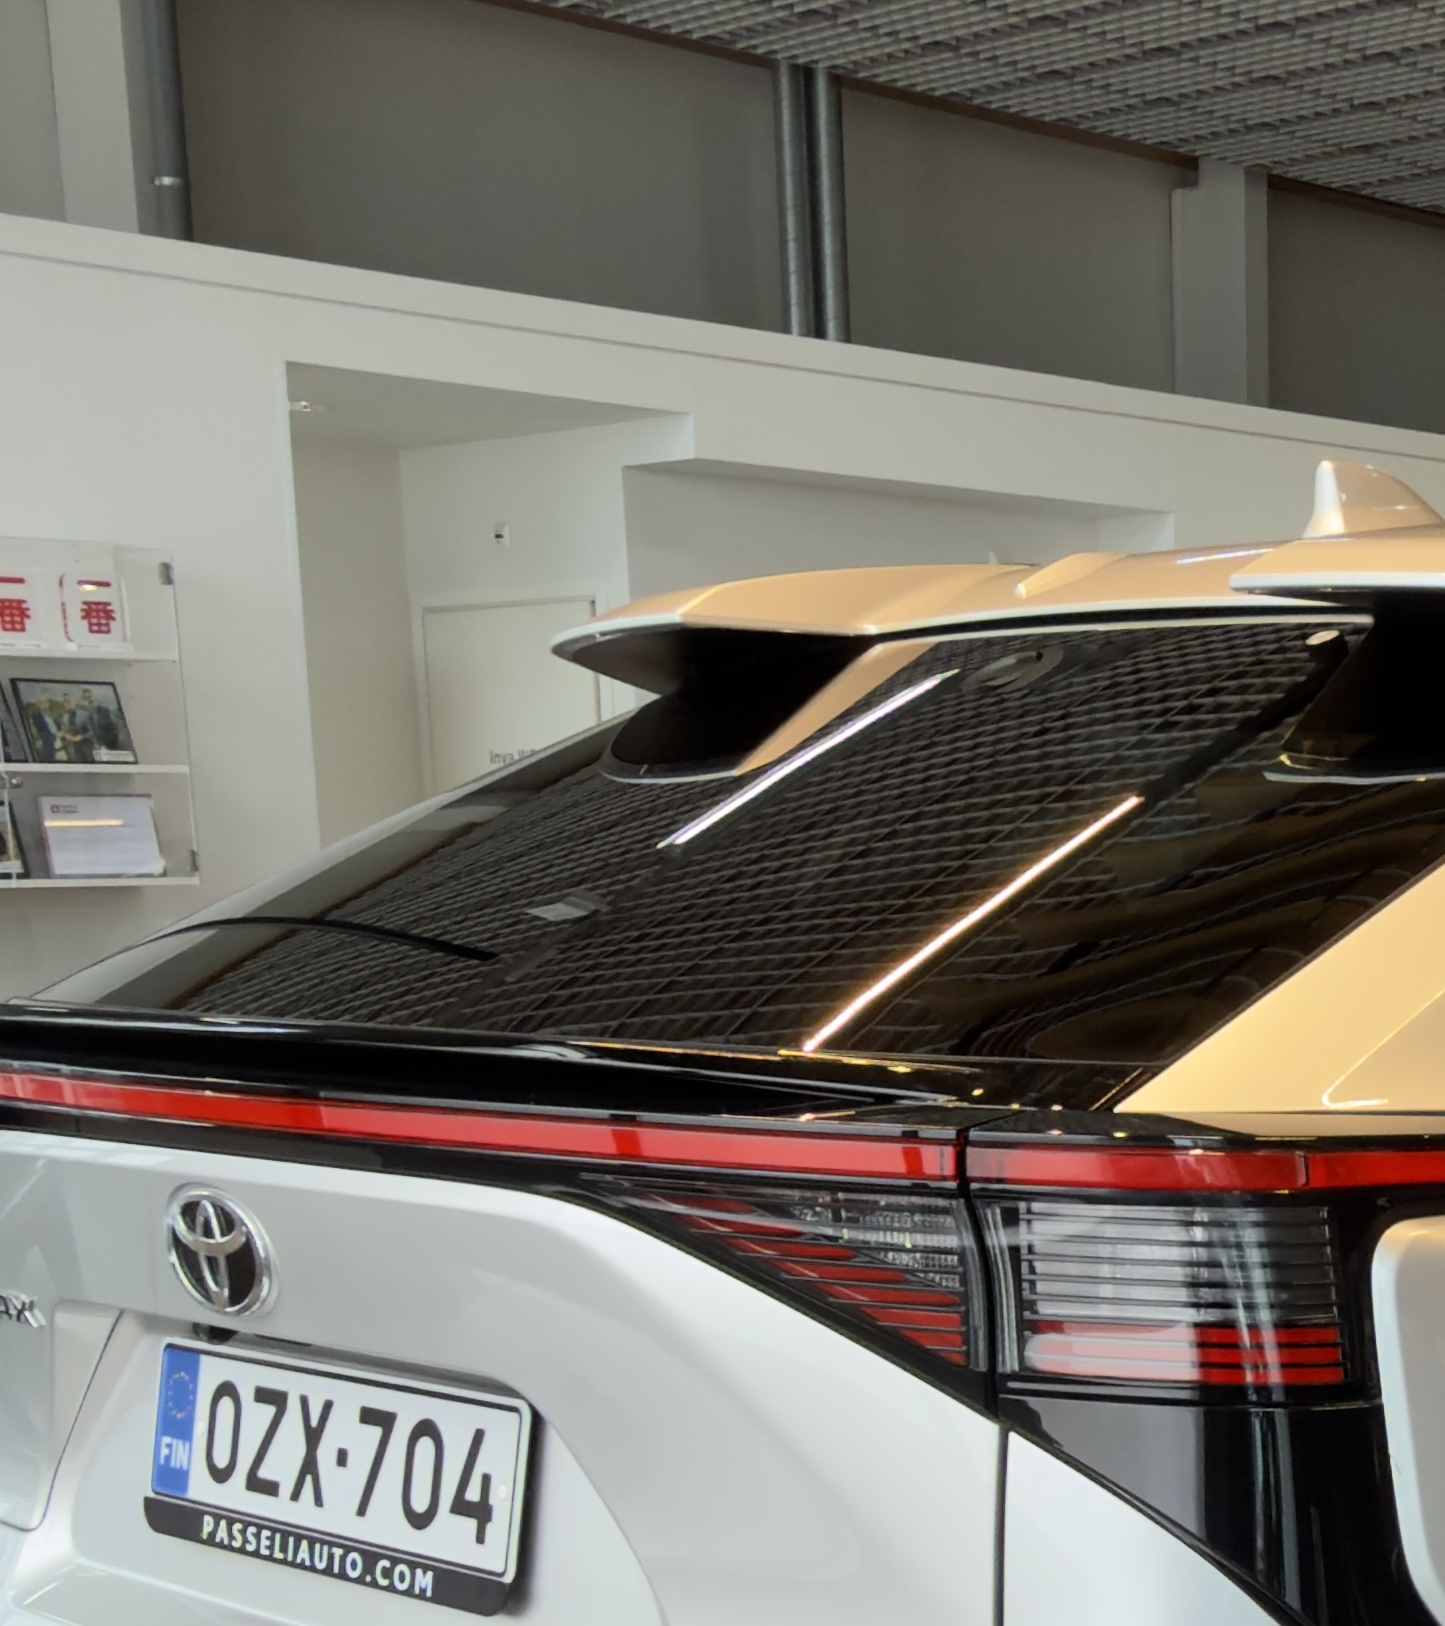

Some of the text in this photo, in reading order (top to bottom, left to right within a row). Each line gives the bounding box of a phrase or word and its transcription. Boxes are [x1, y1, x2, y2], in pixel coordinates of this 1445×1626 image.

[159, 1435, 190, 1472] FIN
[204, 1379, 495, 1546] OZX-704
[200, 1513, 434, 1598] PASSELIAUTO.COM
